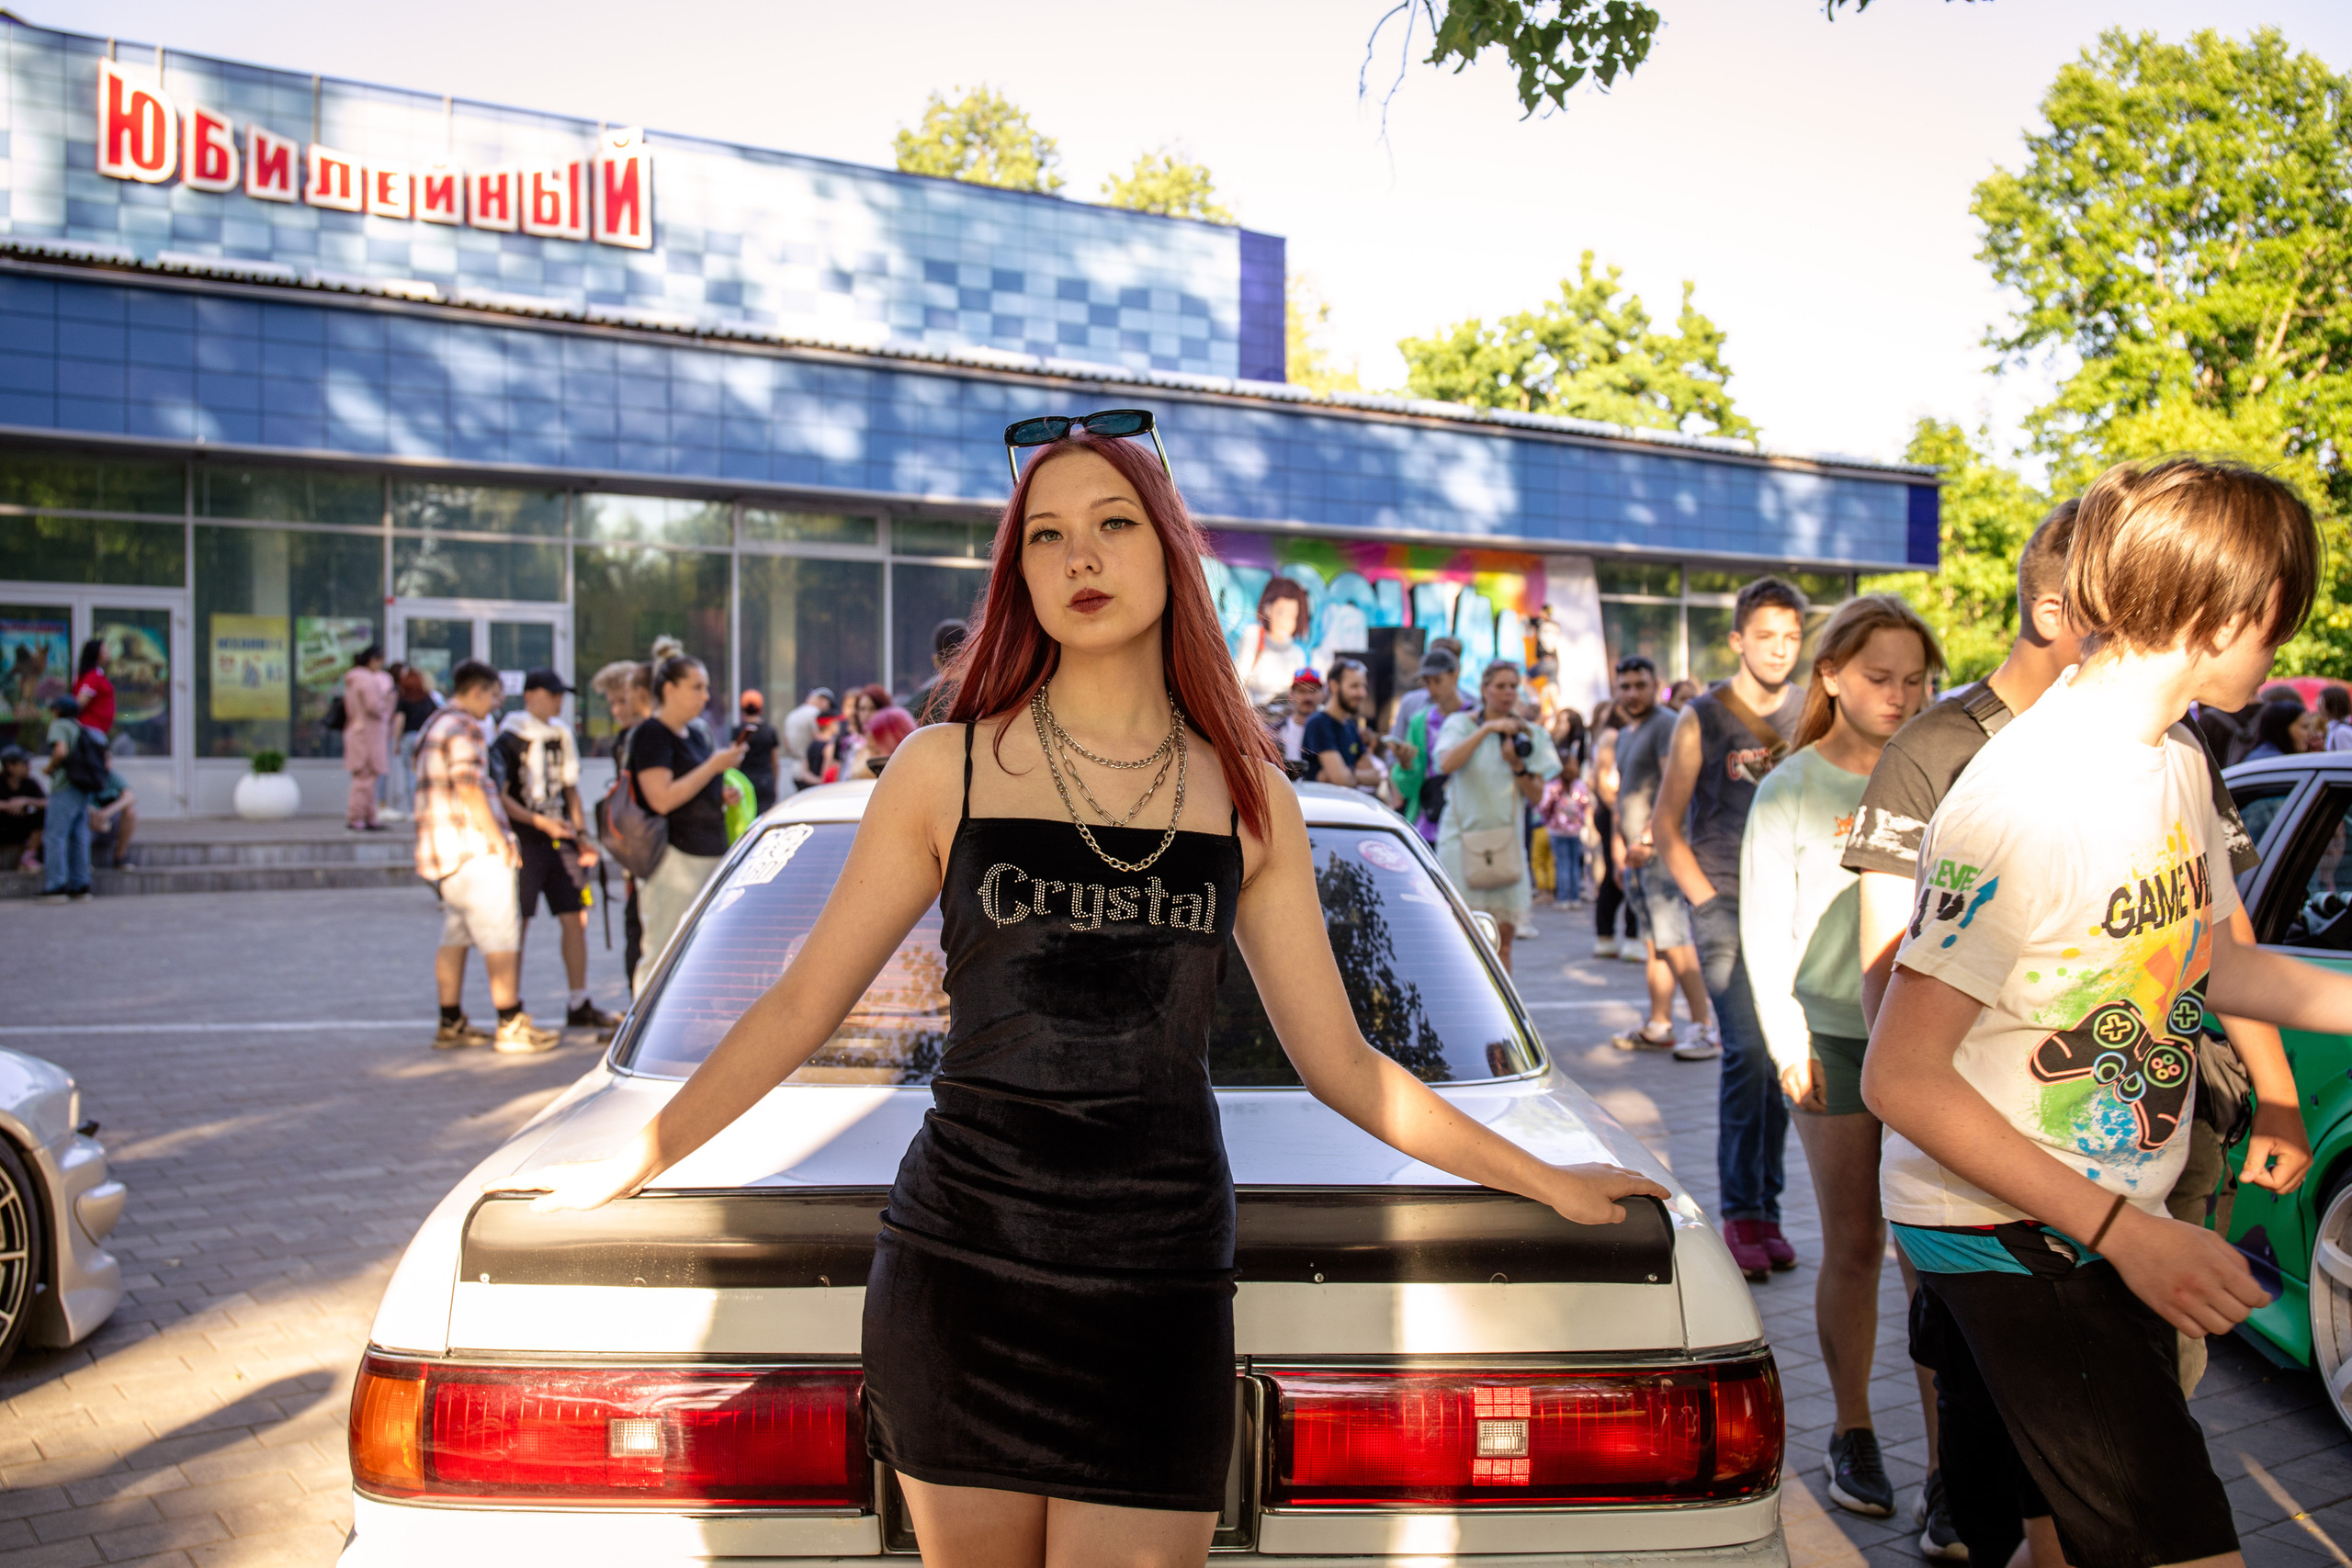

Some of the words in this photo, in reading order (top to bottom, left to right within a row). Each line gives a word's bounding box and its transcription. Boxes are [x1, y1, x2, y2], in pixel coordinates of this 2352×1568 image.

[100, 62, 647, 244] ЮБИЛЕЙНЫЙ
[978, 863, 1216, 933] Crystal
[2101, 863, 2188, 938] GAME
